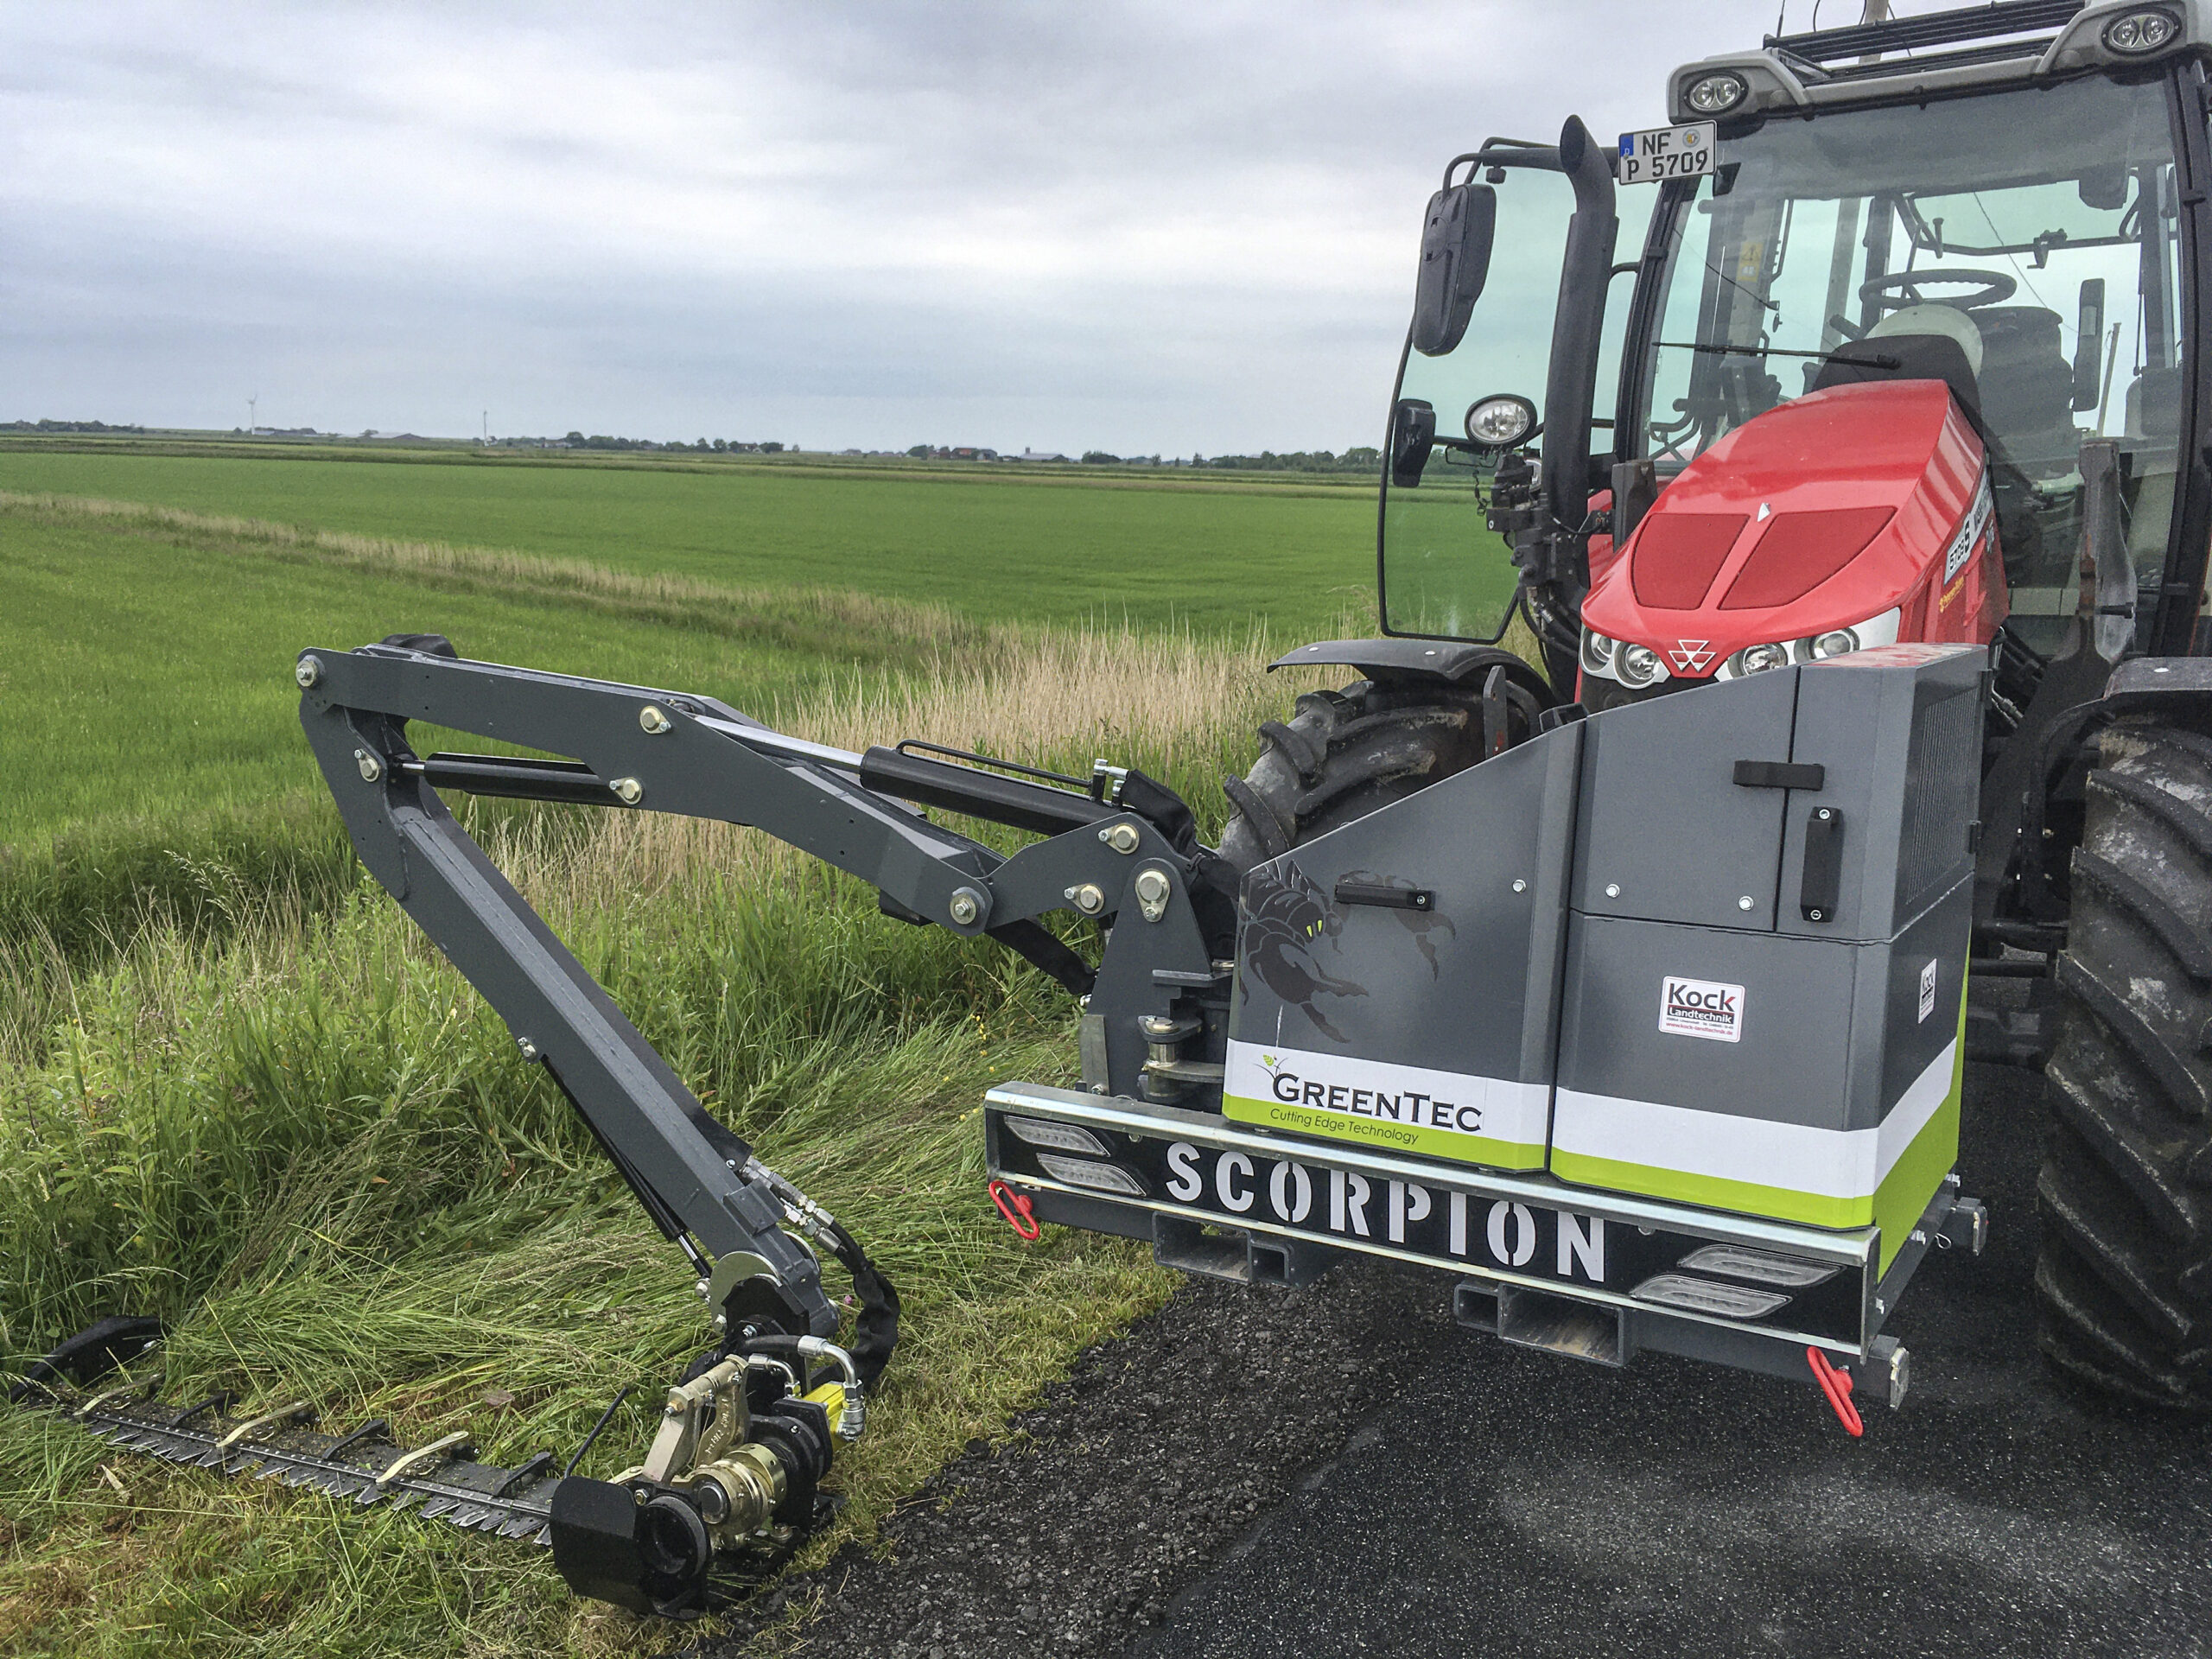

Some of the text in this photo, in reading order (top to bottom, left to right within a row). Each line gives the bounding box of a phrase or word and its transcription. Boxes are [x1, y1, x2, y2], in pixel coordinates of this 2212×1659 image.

[1643, 132, 1671, 156] NF
[1627, 149, 1708, 180] P 5709
[1668, 982, 1736, 1012] Kock
[1669, 1007, 1732, 1023] Landtechnik
[1269, 1108, 1419, 1145] Cutting Edge Technology
[1166, 1141, 1605, 1282] SCORPION
